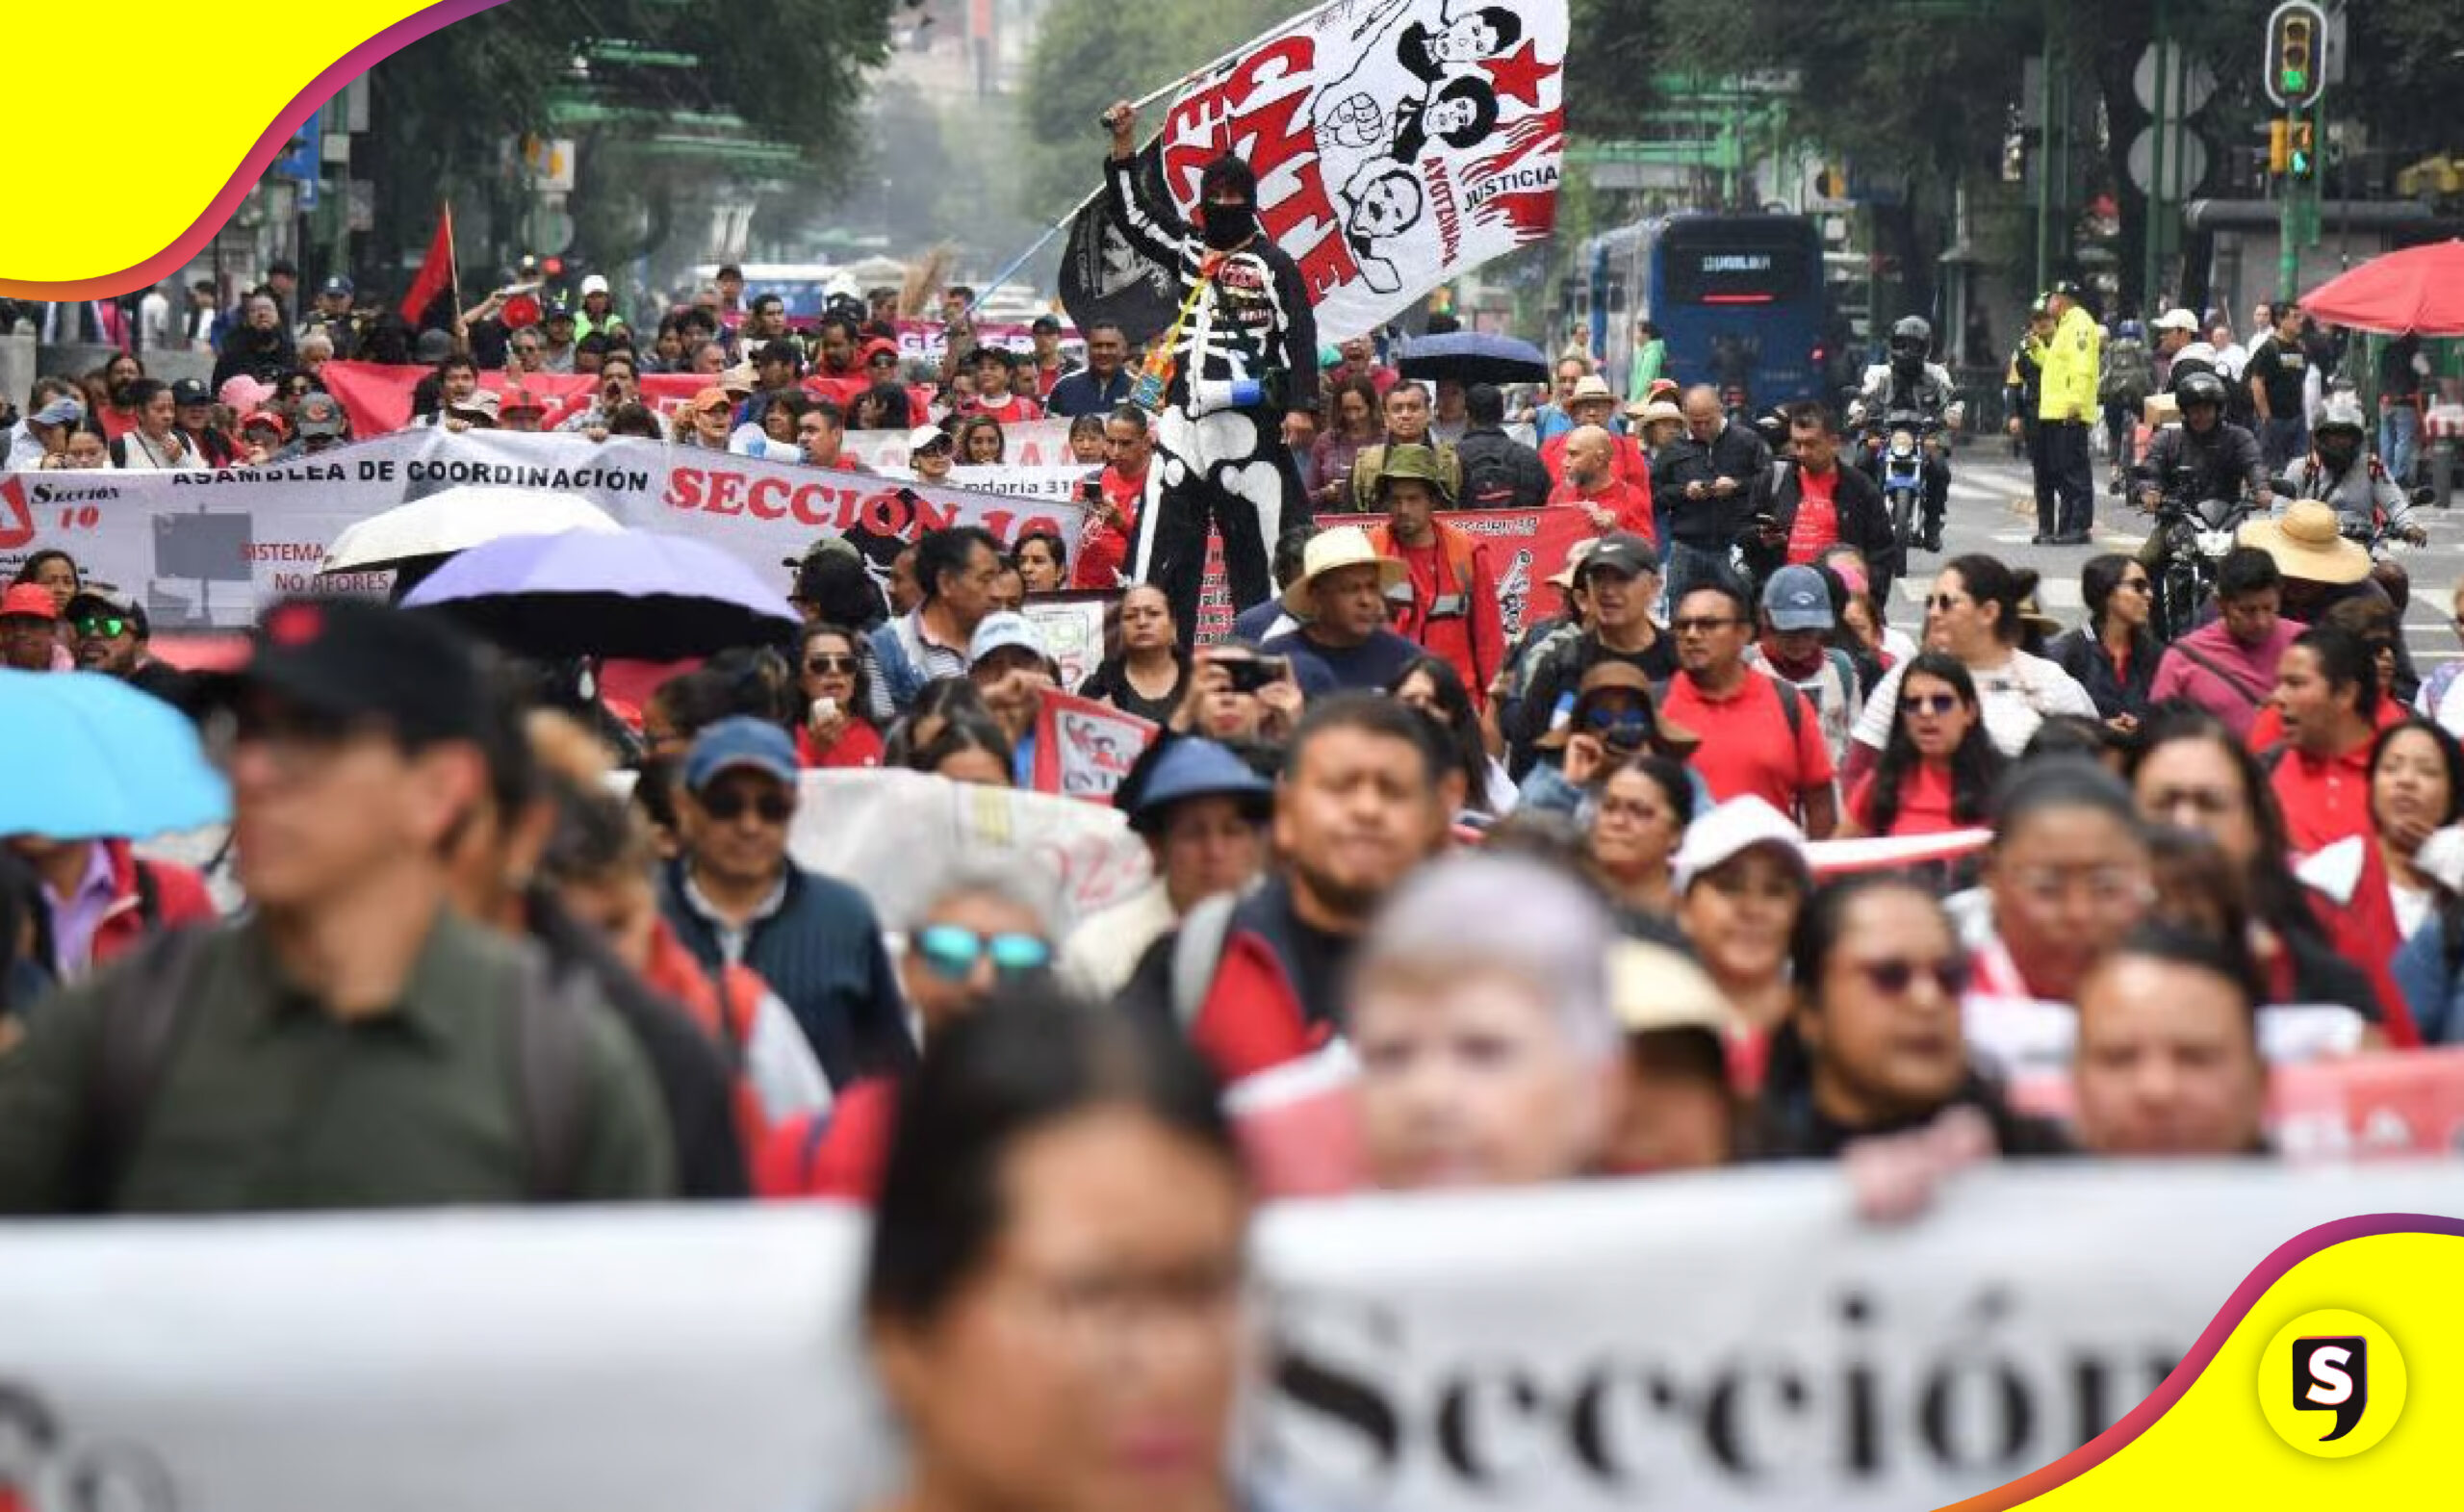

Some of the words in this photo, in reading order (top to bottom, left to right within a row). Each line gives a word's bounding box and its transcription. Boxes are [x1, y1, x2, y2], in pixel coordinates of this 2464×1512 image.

[1222, 36, 1358, 306] CNTE
[1464, 166, 1559, 213] JUSTICIA
[358, 460, 395, 481] DE
[406, 459, 649, 493] COORDINACIÓN
[662, 466, 962, 542] SECCIÓN
[239, 543, 325, 561] SISTEMA
[274, 573, 302, 591] NO
